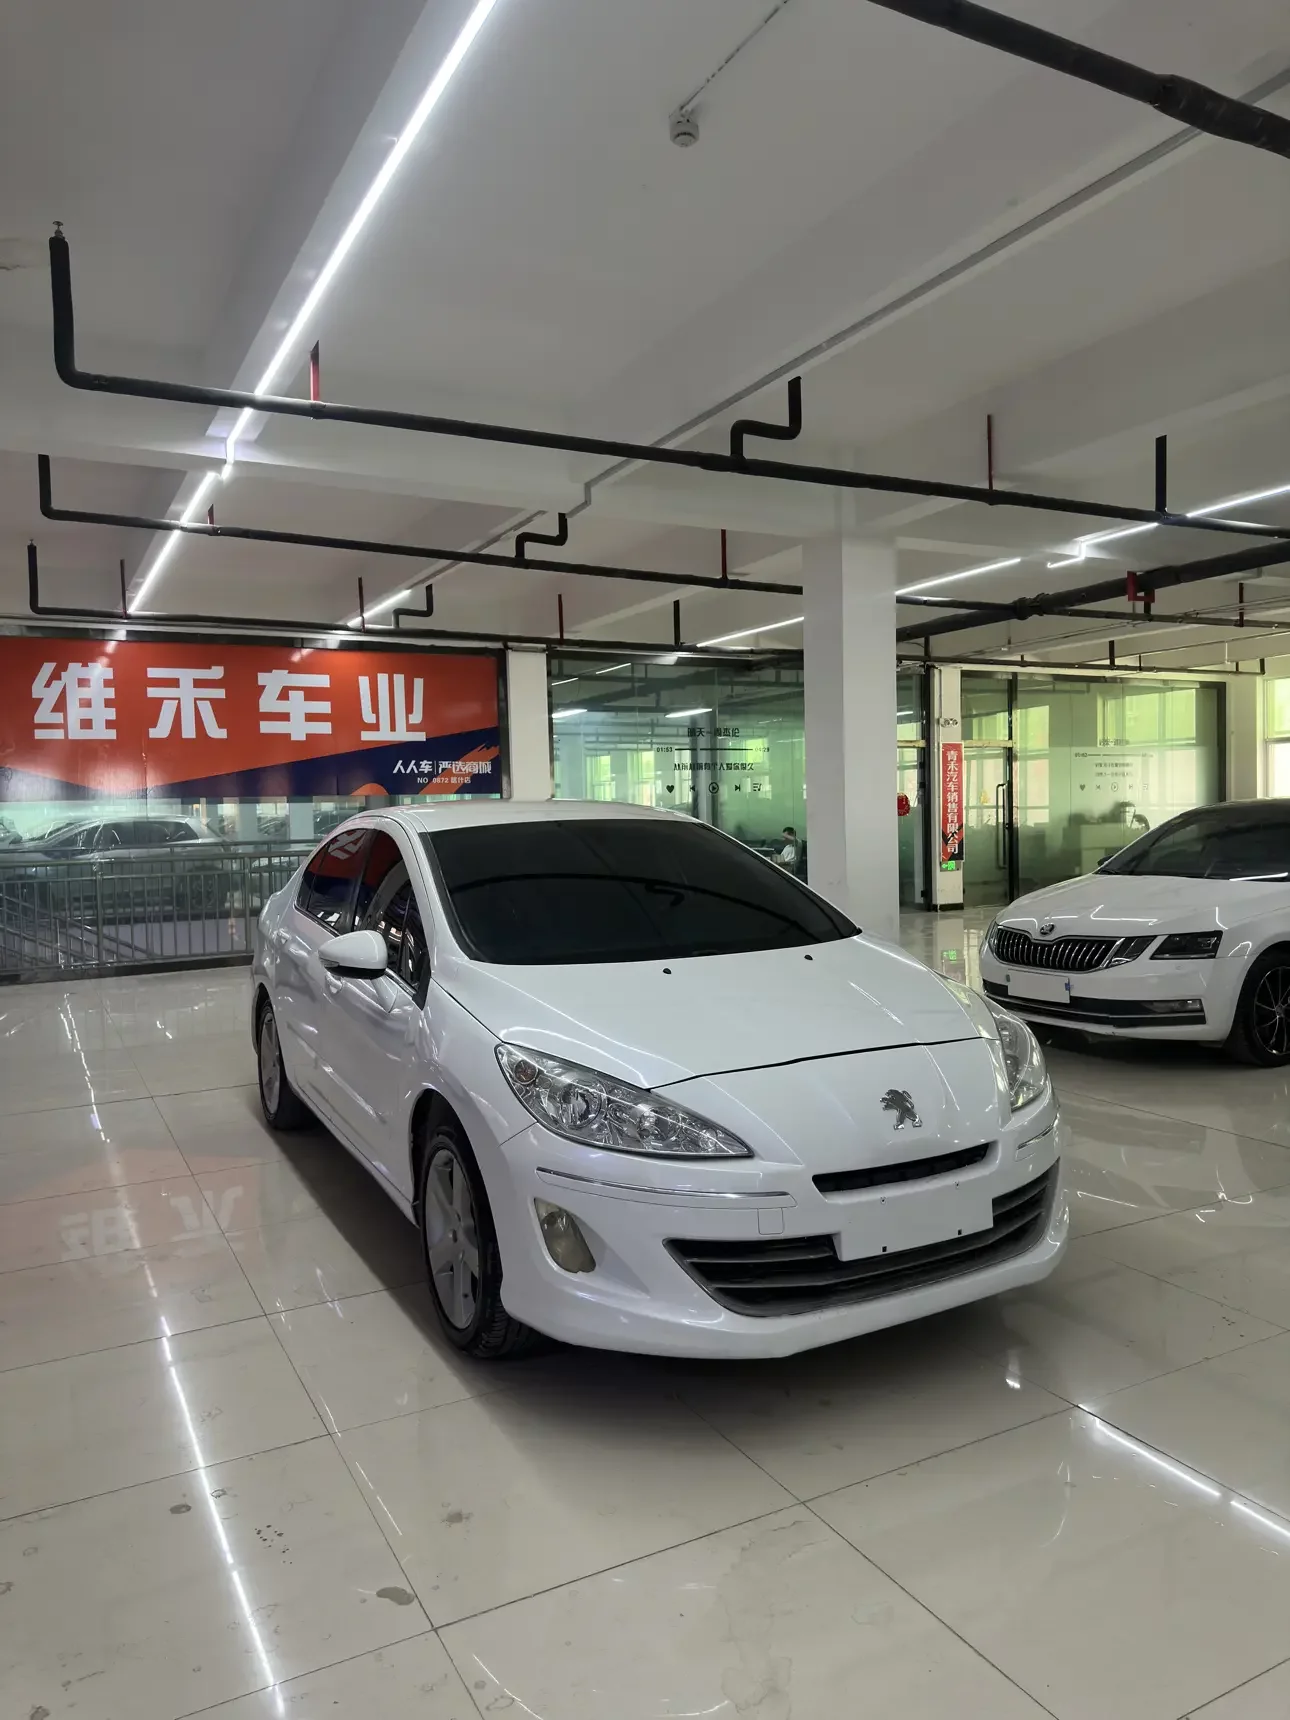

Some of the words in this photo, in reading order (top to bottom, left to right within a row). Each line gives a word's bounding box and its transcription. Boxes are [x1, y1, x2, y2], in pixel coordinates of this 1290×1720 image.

[31, 661, 427, 742] 维禾车业
[392, 760, 433, 774] 人人车
[438, 760, 492, 774] 严选商城
[946, 750, 959, 854] 青禾汽车销售有限公司
